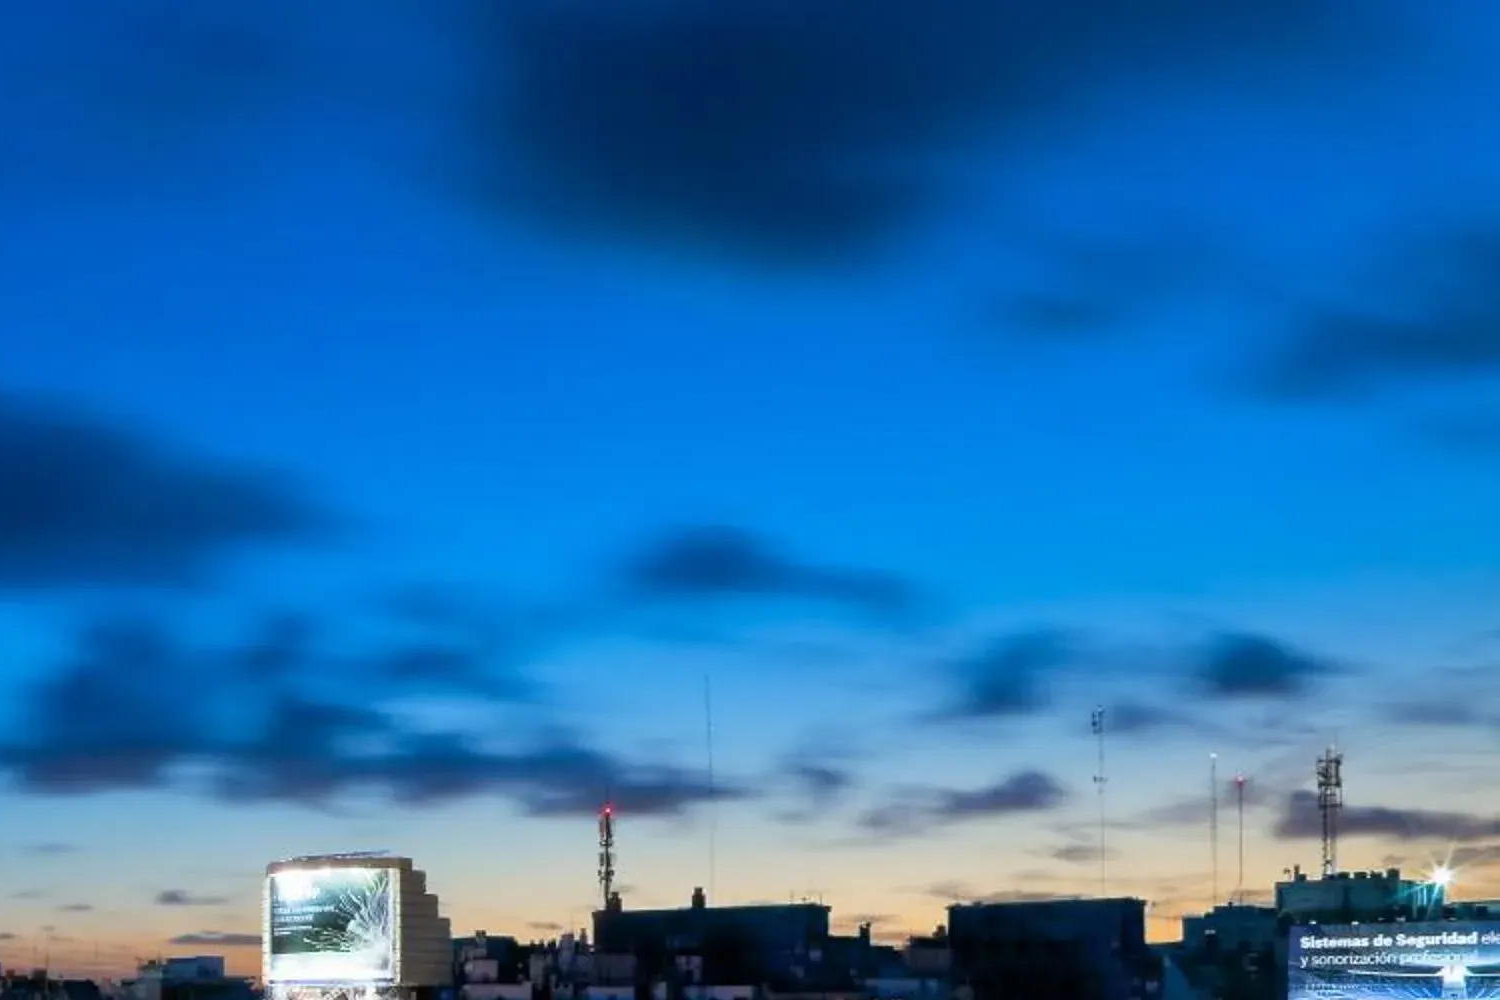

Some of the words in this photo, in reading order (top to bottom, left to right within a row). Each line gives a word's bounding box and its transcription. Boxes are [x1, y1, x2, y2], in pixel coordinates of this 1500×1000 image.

[1300, 935, 1369, 949] Sistemas
[1373, 933, 1393, 947] de
[1396, 931, 1478, 949] Seguridad
[1300, 956, 1308, 969] y
[1312, 951, 1397, 966] sonorización
